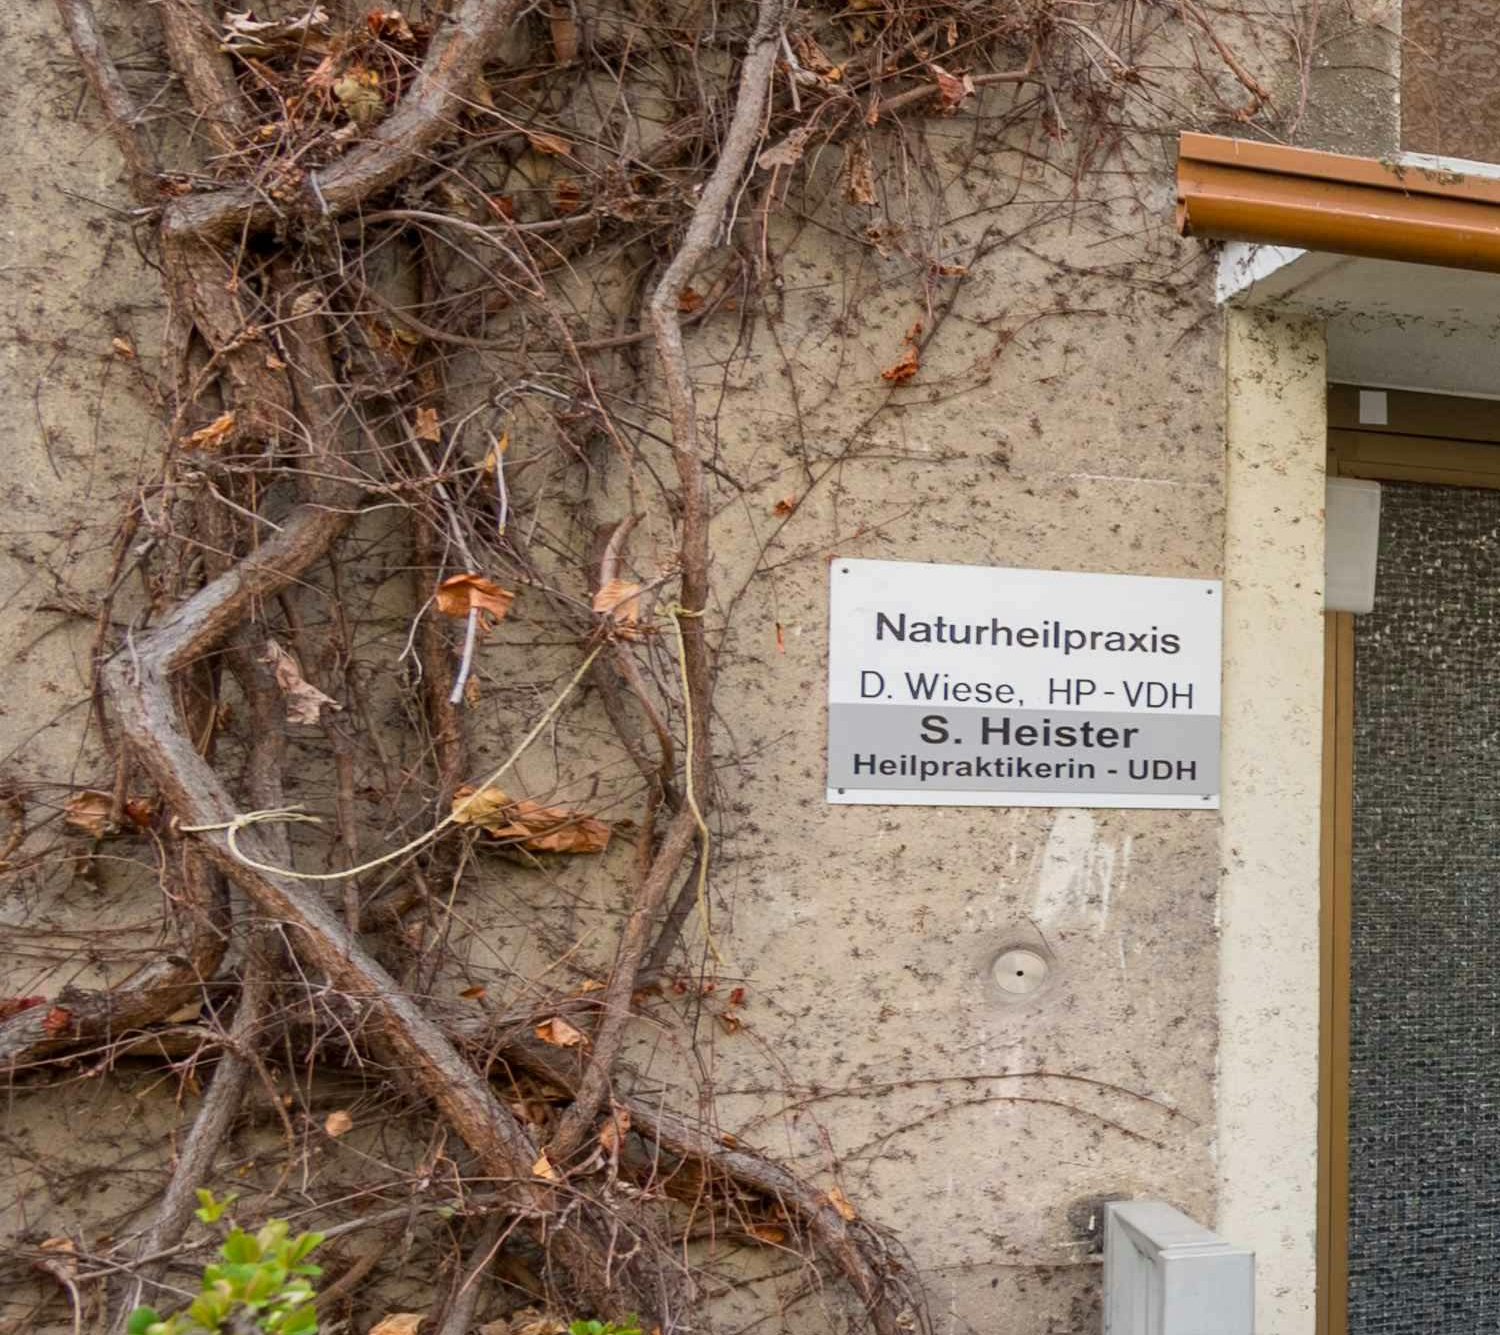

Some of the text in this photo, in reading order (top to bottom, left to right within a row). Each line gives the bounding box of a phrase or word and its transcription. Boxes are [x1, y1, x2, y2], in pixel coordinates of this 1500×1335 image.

[875, 611, 1181, 655] Naturheilpraxis
[860, 669, 893, 699] D.
[903, 671, 1024, 706] Wiese,
[919, 714, 1140, 749] S. Heister
[853, 753, 1095, 782] Heilpraktikerin
[1128, 759, 1197, 781] UDH
